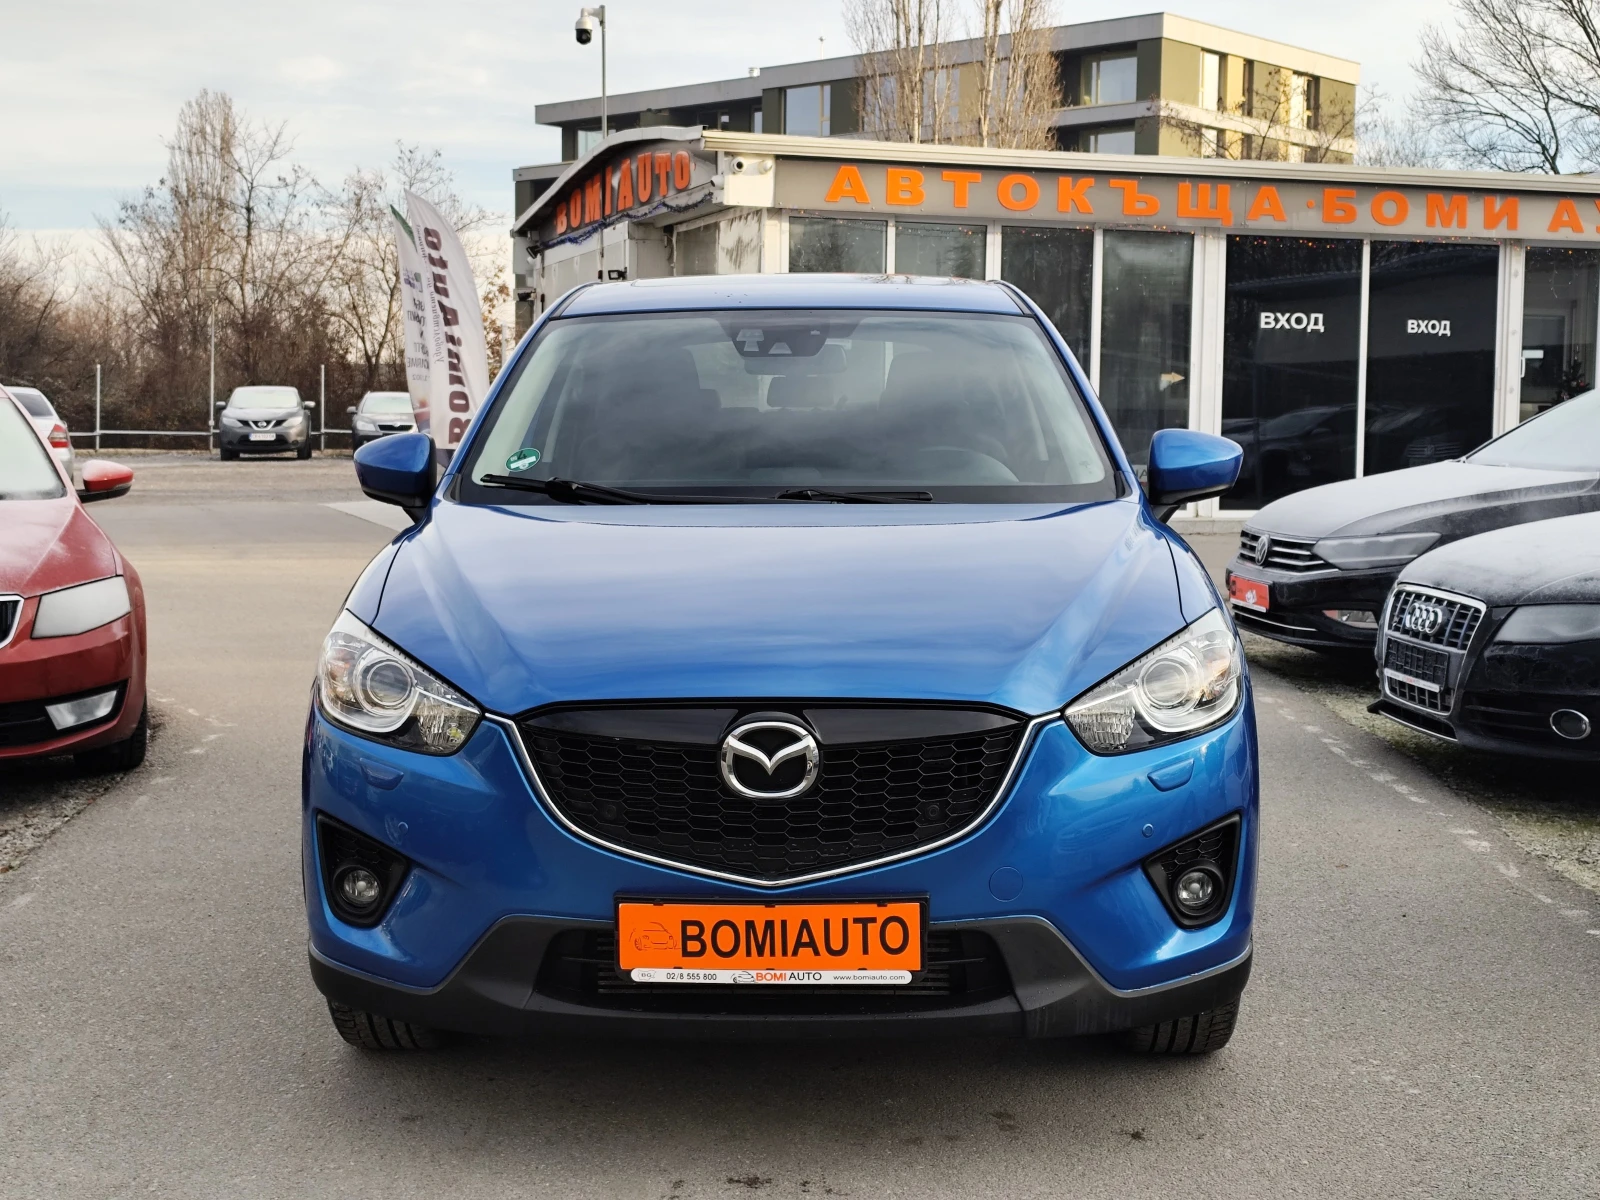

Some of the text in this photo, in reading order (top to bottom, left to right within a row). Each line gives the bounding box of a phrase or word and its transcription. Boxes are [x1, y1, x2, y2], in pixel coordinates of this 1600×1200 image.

[556, 151, 691, 235] BOMIAUTO
[825, 165, 1600, 234] АВТОКЪЩА БОМИ А
[1260, 312, 1325, 333] ВХОД
[1407, 319, 1451, 337] ВХОД
[680, 915, 910, 959] BOMIAUTO
[666, 972, 718, 981] 02/8 555 800
[755, 971, 823, 982] BOMI AUTO
[833, 973, 906, 981] www.bomiauto.com
